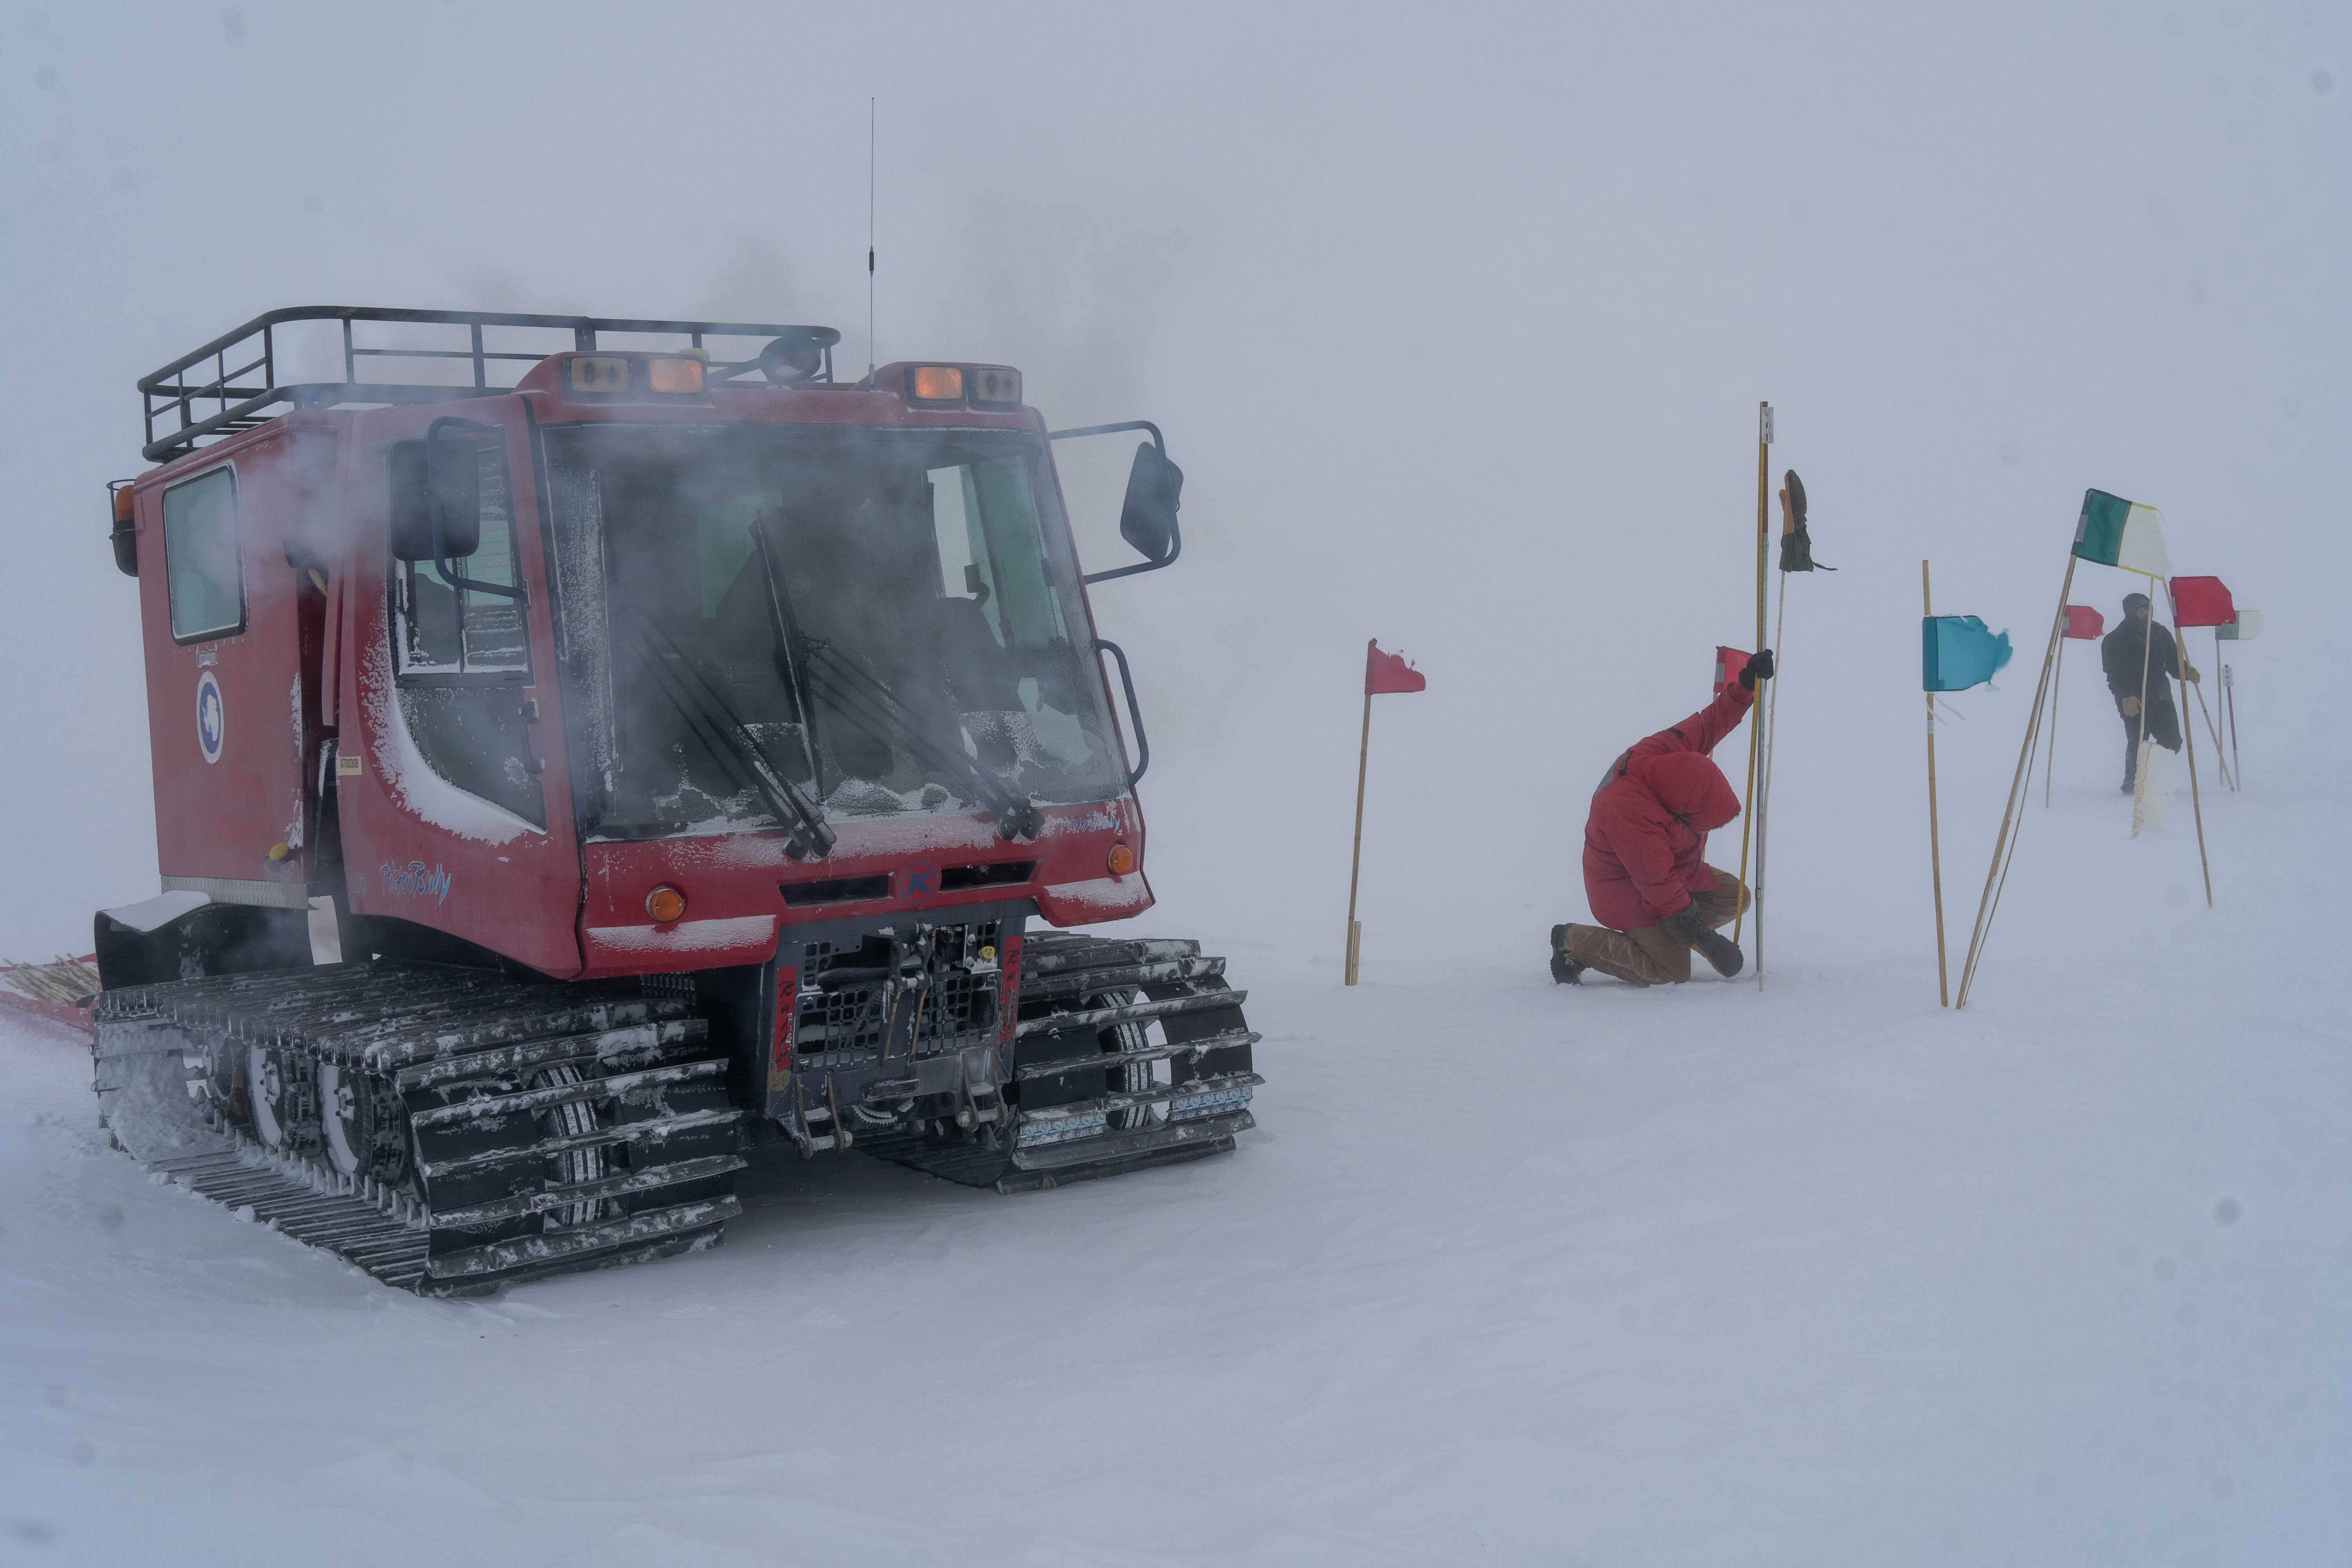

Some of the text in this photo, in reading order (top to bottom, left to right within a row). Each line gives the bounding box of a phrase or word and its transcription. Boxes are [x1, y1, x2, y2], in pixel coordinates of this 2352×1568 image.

[340, 758, 359, 769] AT00308
[350, 860, 451, 906] 100 PistenBully
[902, 871, 936, 896] K
